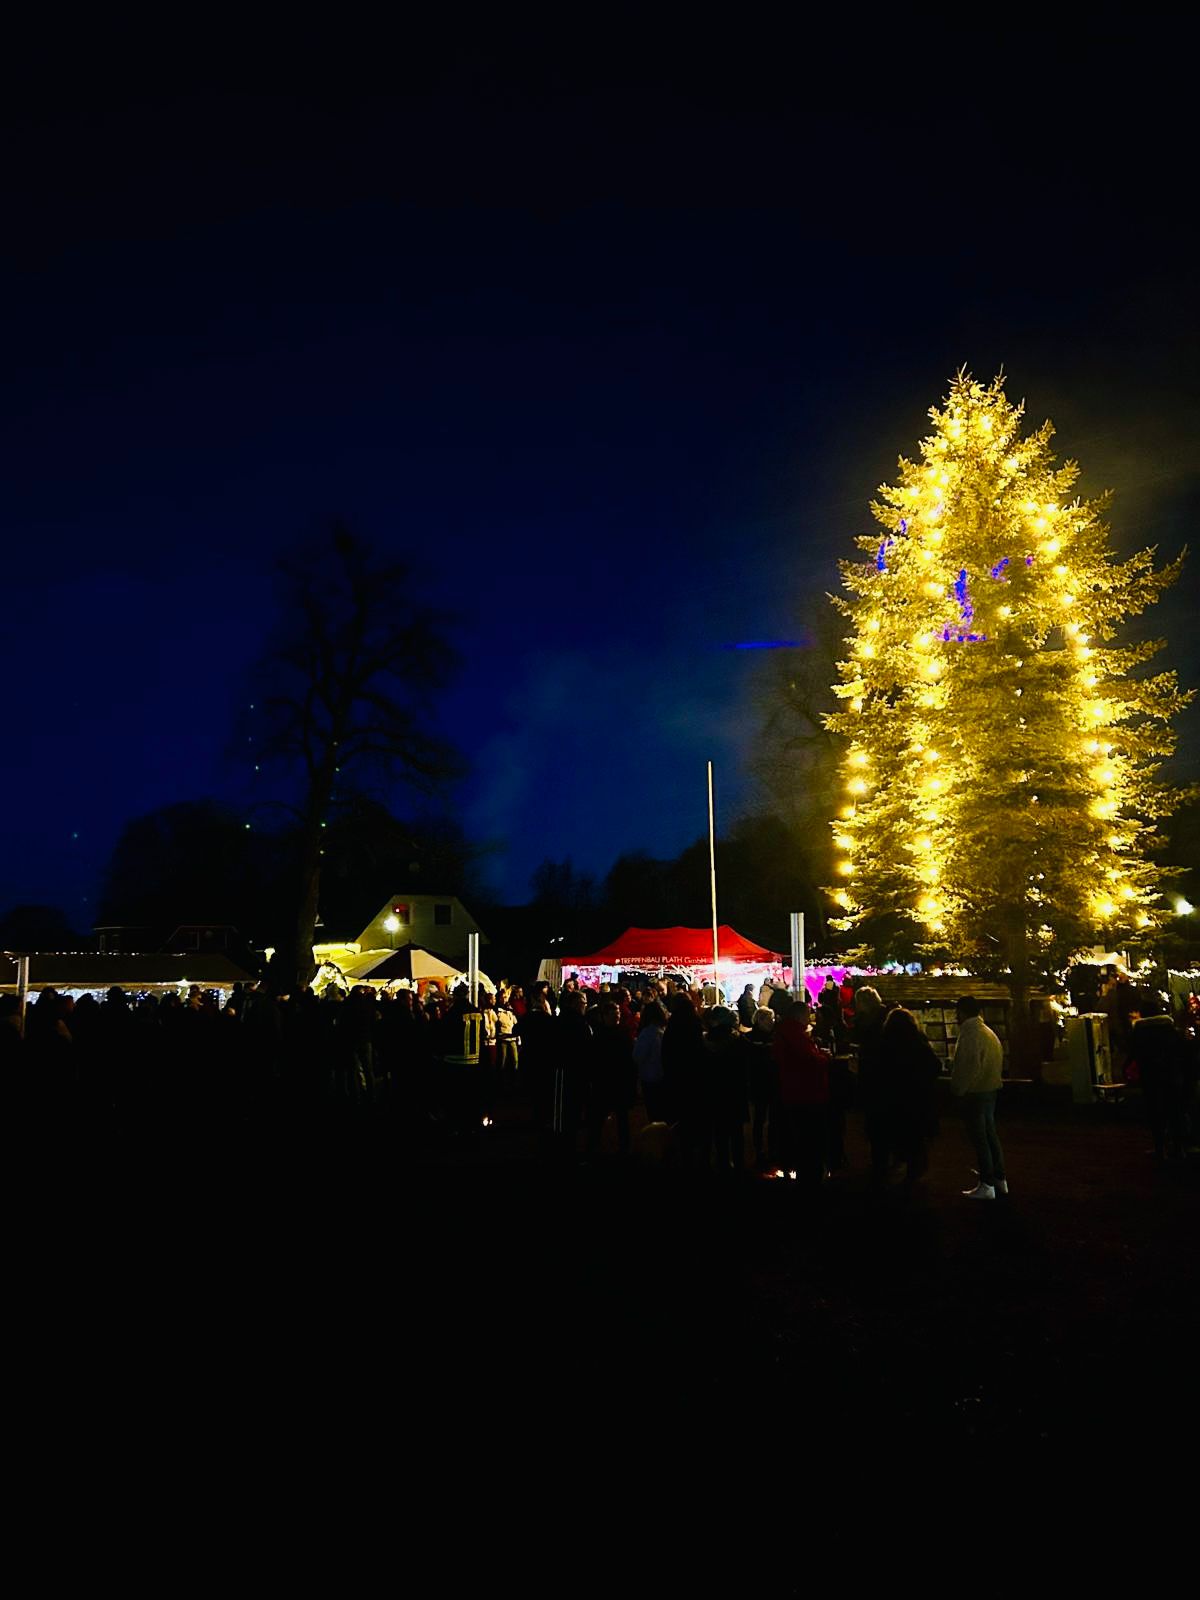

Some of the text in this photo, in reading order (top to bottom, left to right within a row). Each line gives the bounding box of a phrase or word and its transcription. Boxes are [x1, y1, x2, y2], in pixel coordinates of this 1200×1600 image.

[621, 955, 707, 964] TREPPENBAU PLATH GmbH
